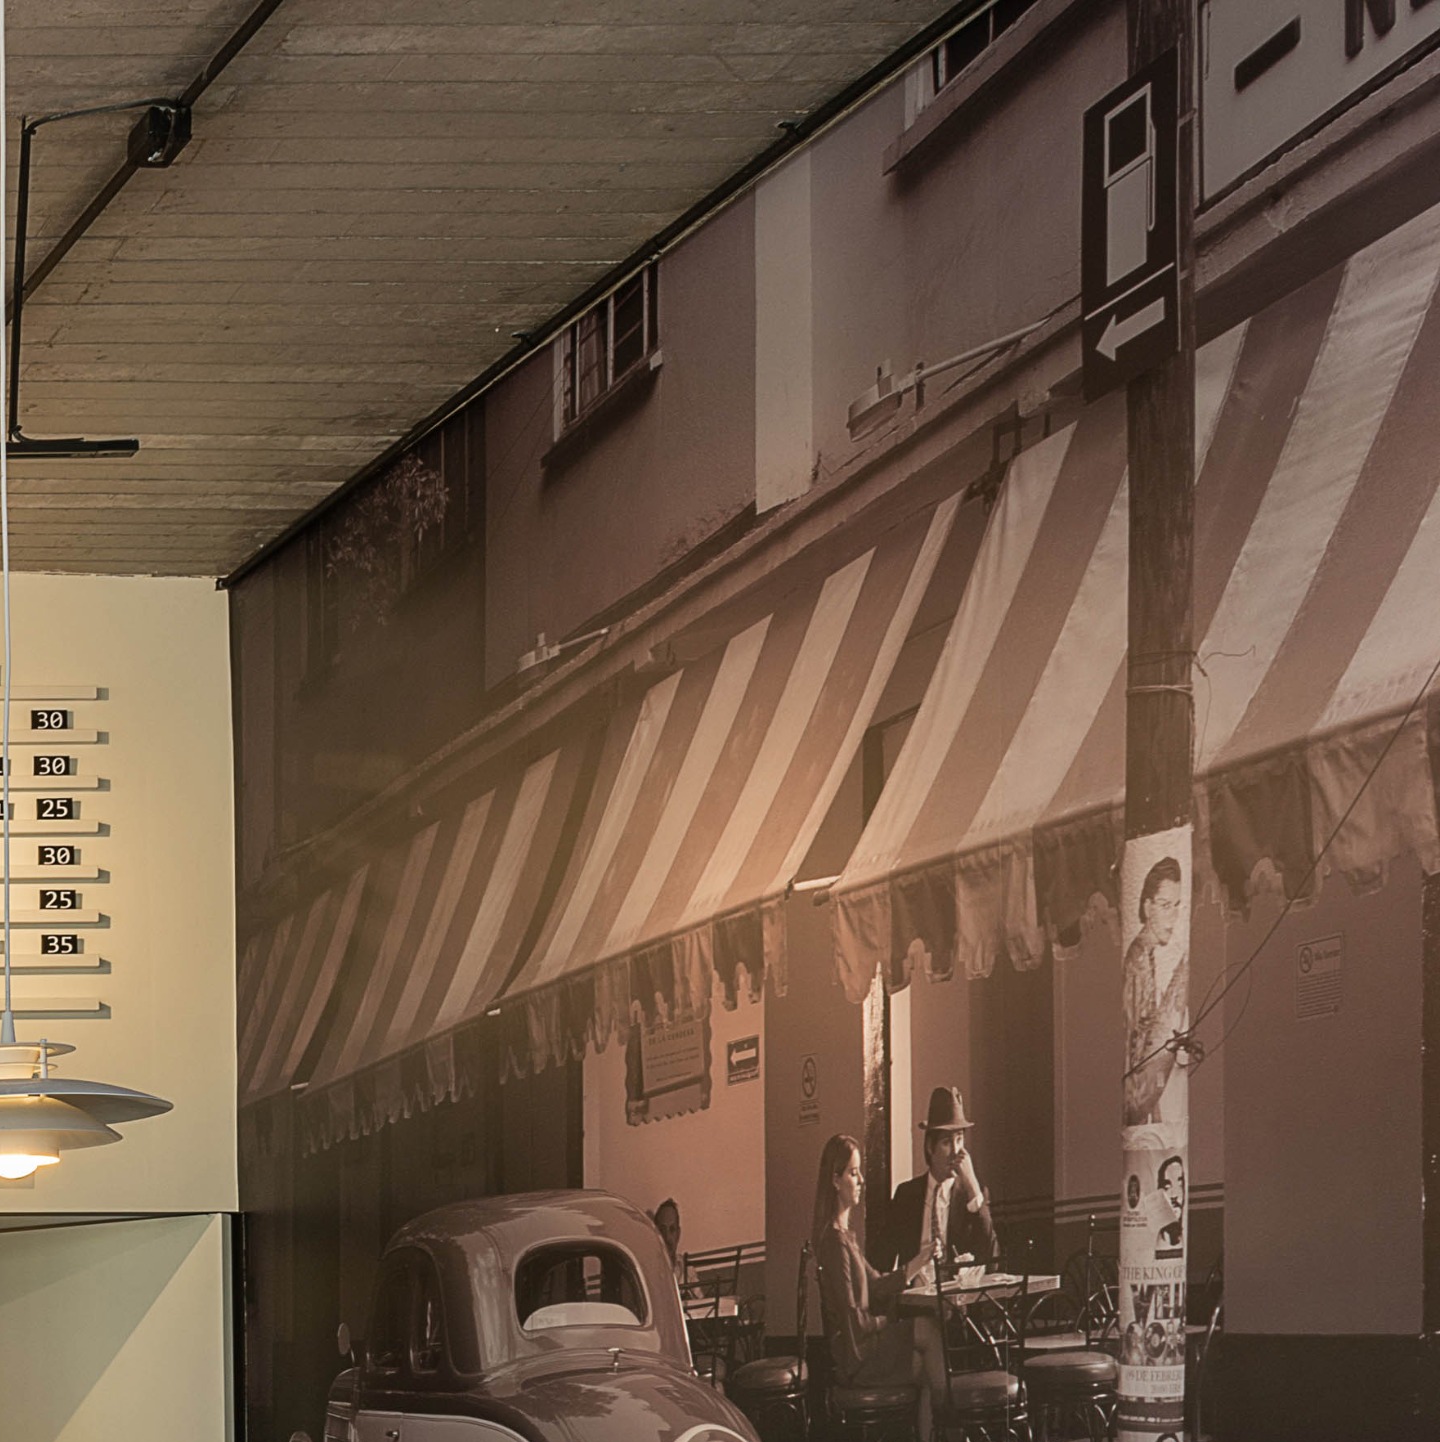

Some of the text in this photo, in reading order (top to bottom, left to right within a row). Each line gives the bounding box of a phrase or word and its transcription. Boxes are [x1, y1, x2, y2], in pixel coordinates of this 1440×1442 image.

[37, 712, 63, 729] 30
[39, 757, 65, 775] 30
[42, 799, 69, 817] 25
[43, 848, 70, 864] 30
[45, 892, 72, 908] 25
[47, 936, 73, 953] 35
